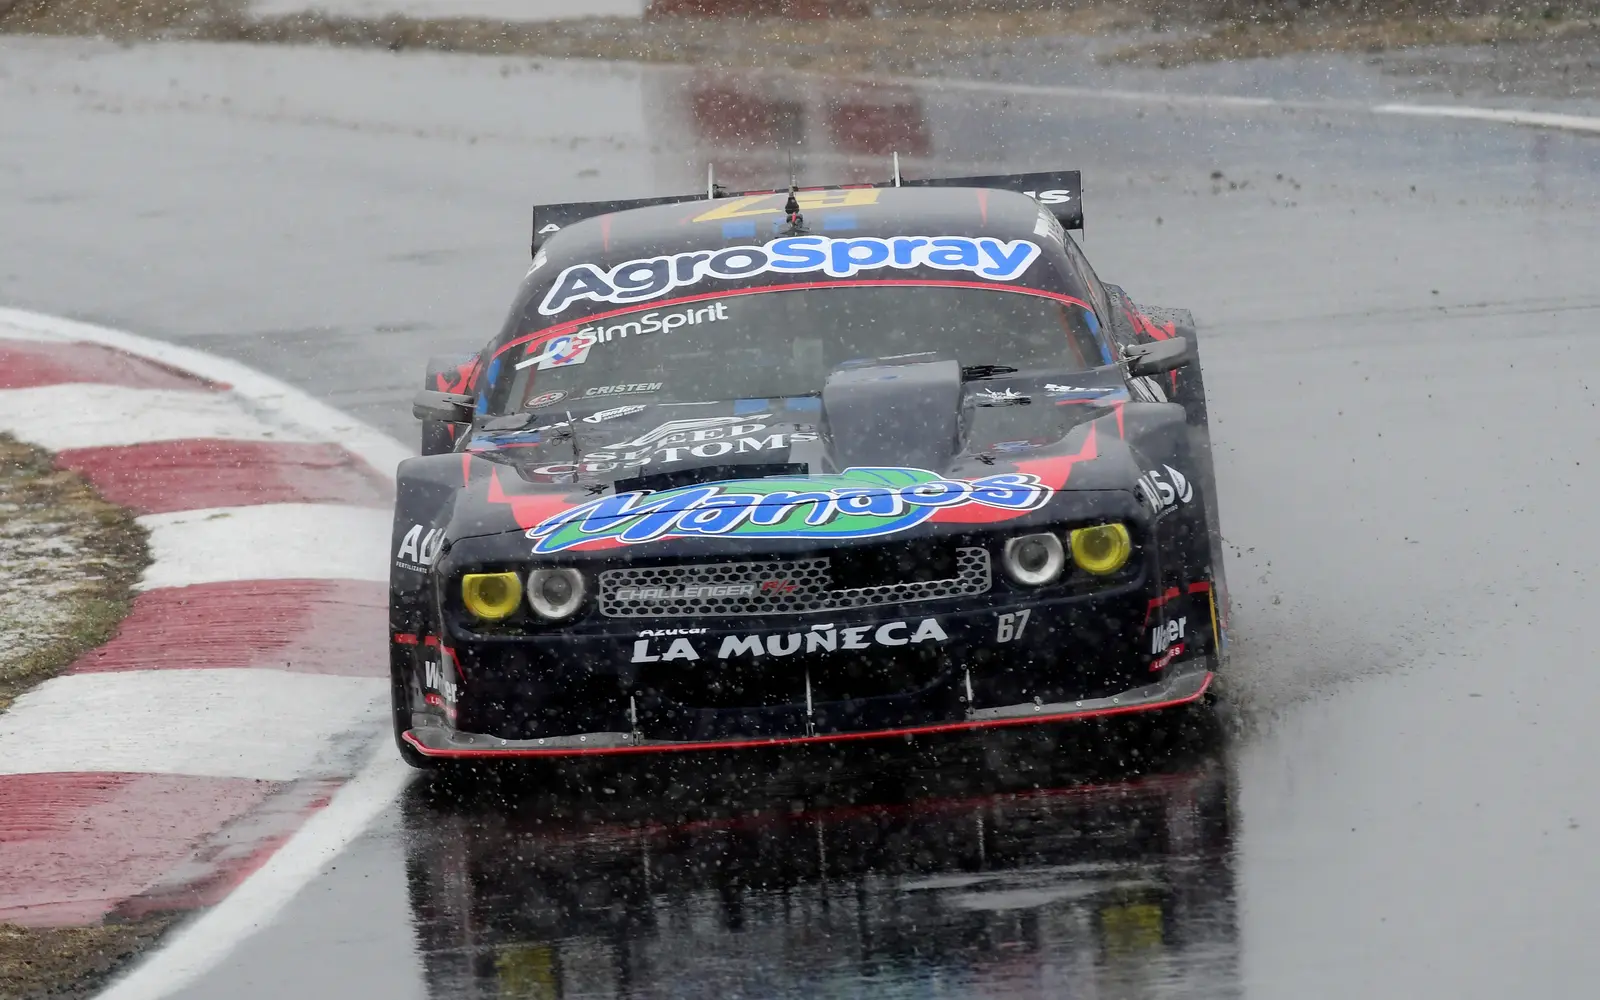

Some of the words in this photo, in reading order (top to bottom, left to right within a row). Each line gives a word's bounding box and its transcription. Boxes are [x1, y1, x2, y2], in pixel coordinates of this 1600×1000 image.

[538, 235, 1042, 316] AgroSpray
[577, 302, 729, 348] SimSpirit
[586, 382, 663, 396] CRISTEM
[533, 431, 819, 475] CUSTOMS
[615, 583, 755, 601] CHALLENGER
[761, 579, 799, 596] R/T
[631, 637, 700, 663] LA
[717, 617, 949, 659] MUÑECA
[996, 608, 1032, 643] 67
